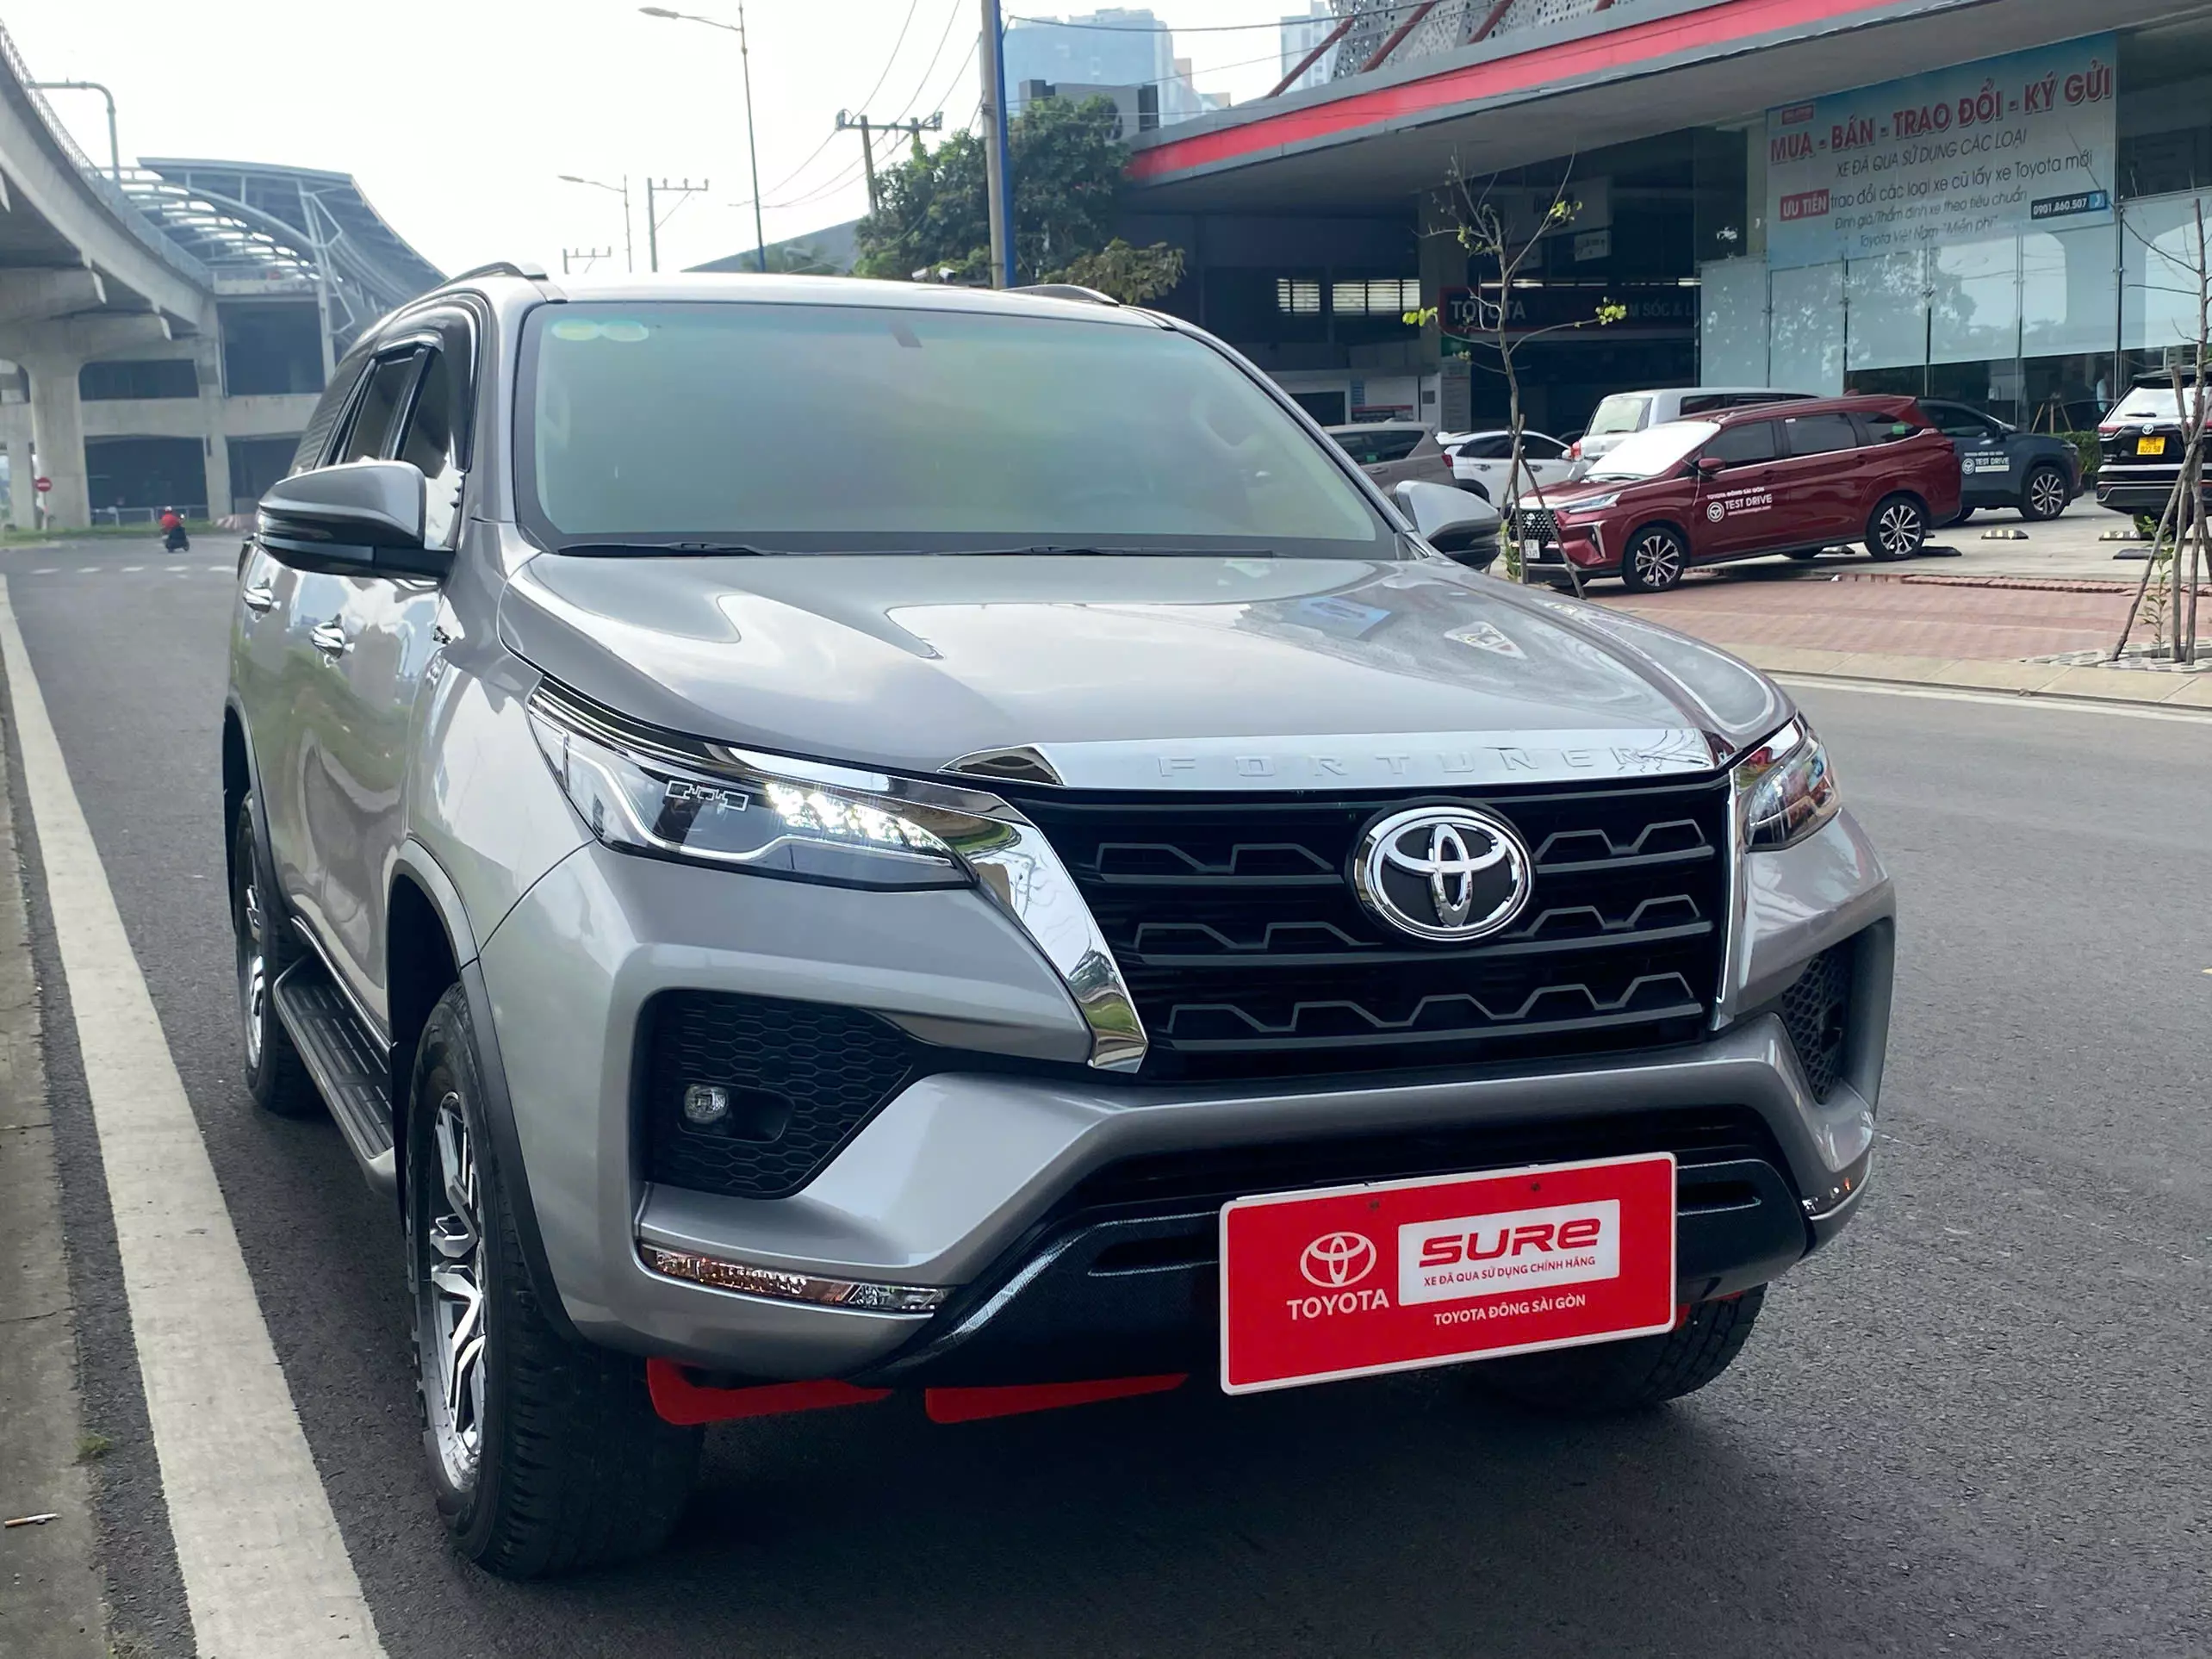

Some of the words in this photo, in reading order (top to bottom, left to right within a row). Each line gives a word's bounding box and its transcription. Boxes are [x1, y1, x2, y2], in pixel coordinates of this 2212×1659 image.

[1770, 132, 1815, 165] MUA
[1831, 114, 1875, 152] BÁN
[1892, 102, 1952, 140] TRAO
[1958, 78, 2003, 127] ĐỔI
[2025, 71, 2059, 114] KÝ
[2065, 59, 2113, 105] GỬI
[1836, 162, 1850, 178] XE
[1873, 152, 1899, 171] QUA
[1920, 140, 1957, 166] DỤNG
[1960, 133, 1992, 156] CÁC
[1996, 128, 2027, 150] LOẠI
[1830, 193, 1854, 209] trao
[1880, 184, 1904, 202] các
[1934, 177, 1948, 191] xe
[1996, 167, 2011, 182] xe
[2015, 158, 2061, 180] Toyota
[2066, 149, 2093, 168] mới
[1724, 498, 1744, 510] TEST
[1745, 494, 1773, 506] DRIVE
[1157, 746, 1643, 777] FORTUNER
[1424, 1275, 1437, 1288] XE
[1438, 1271, 1454, 1285] ĐÃ
[1457, 1270, 1479, 1283] QUA
[1482, 1265, 1497, 1279] SỬ
[1497, 1264, 1528, 1280] DỤNG
[1530, 1258, 1563, 1275] CHÍNH
[1565, 1255, 1596, 1271] HÃNG
[1286, 1289, 1389, 1321] TOYOTA
[1433, 1308, 1487, 1327] TOYOTA
[1488, 1302, 1530, 1319] ĐÔNG
[1532, 1295, 1552, 1314] SÀI
[1554, 1292, 1586, 1310] GÒN
